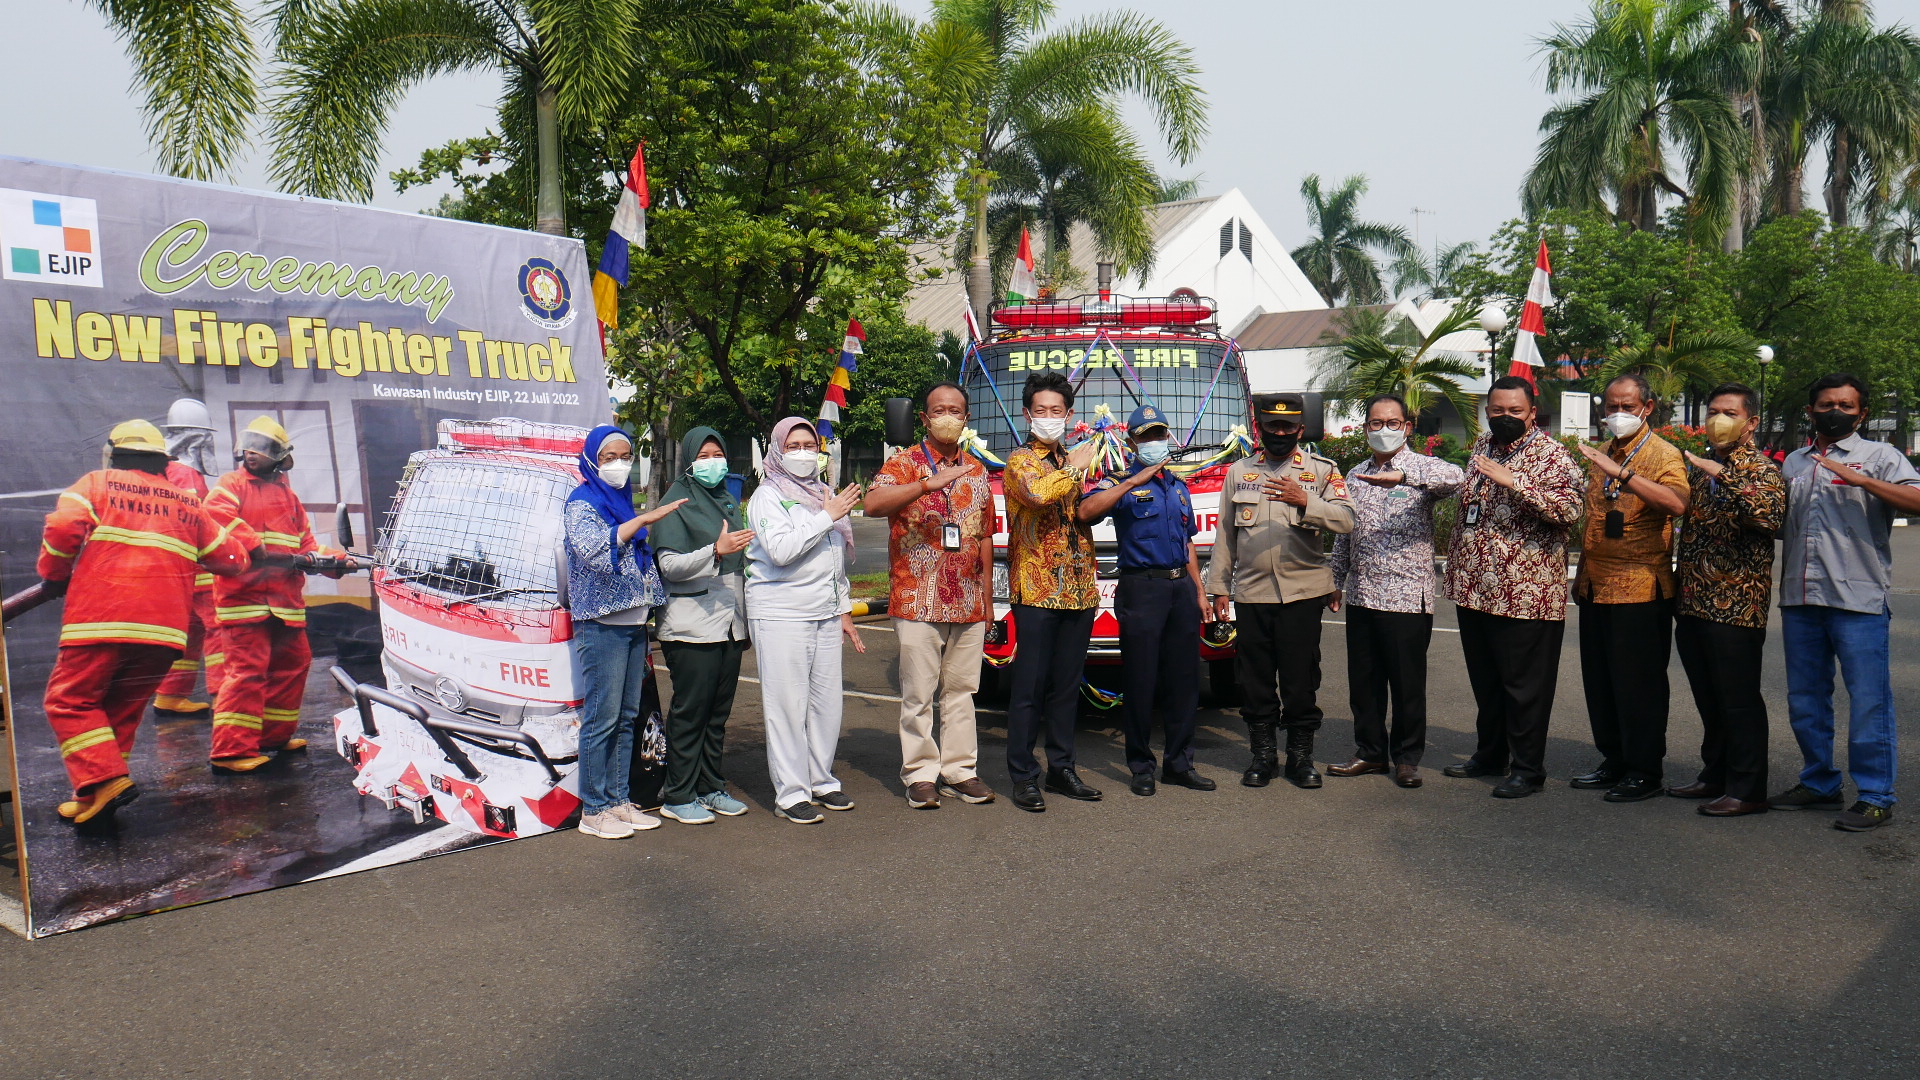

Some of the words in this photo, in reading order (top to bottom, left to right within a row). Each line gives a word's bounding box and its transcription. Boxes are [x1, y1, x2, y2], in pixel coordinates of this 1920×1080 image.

[48, 254, 92, 276] EJIP
[139, 218, 455, 323] Ceremony
[33, 298, 162, 363] New
[173, 309, 280, 368] Fire
[287, 315, 453, 377] Fighter
[457, 330, 577, 383] Truck
[372, 384, 431, 399] Kawasan
[433, 387, 482, 403] Industry
[485, 389, 513, 404] EJIP,
[514, 391, 530, 403] 22
[531, 391, 550, 404] Juli
[552, 393, 579, 405] 2022
[108, 481, 150, 496] PEMADAM
[110, 496, 169, 517] KAWASAN
[500, 662, 551, 688] FIRE
